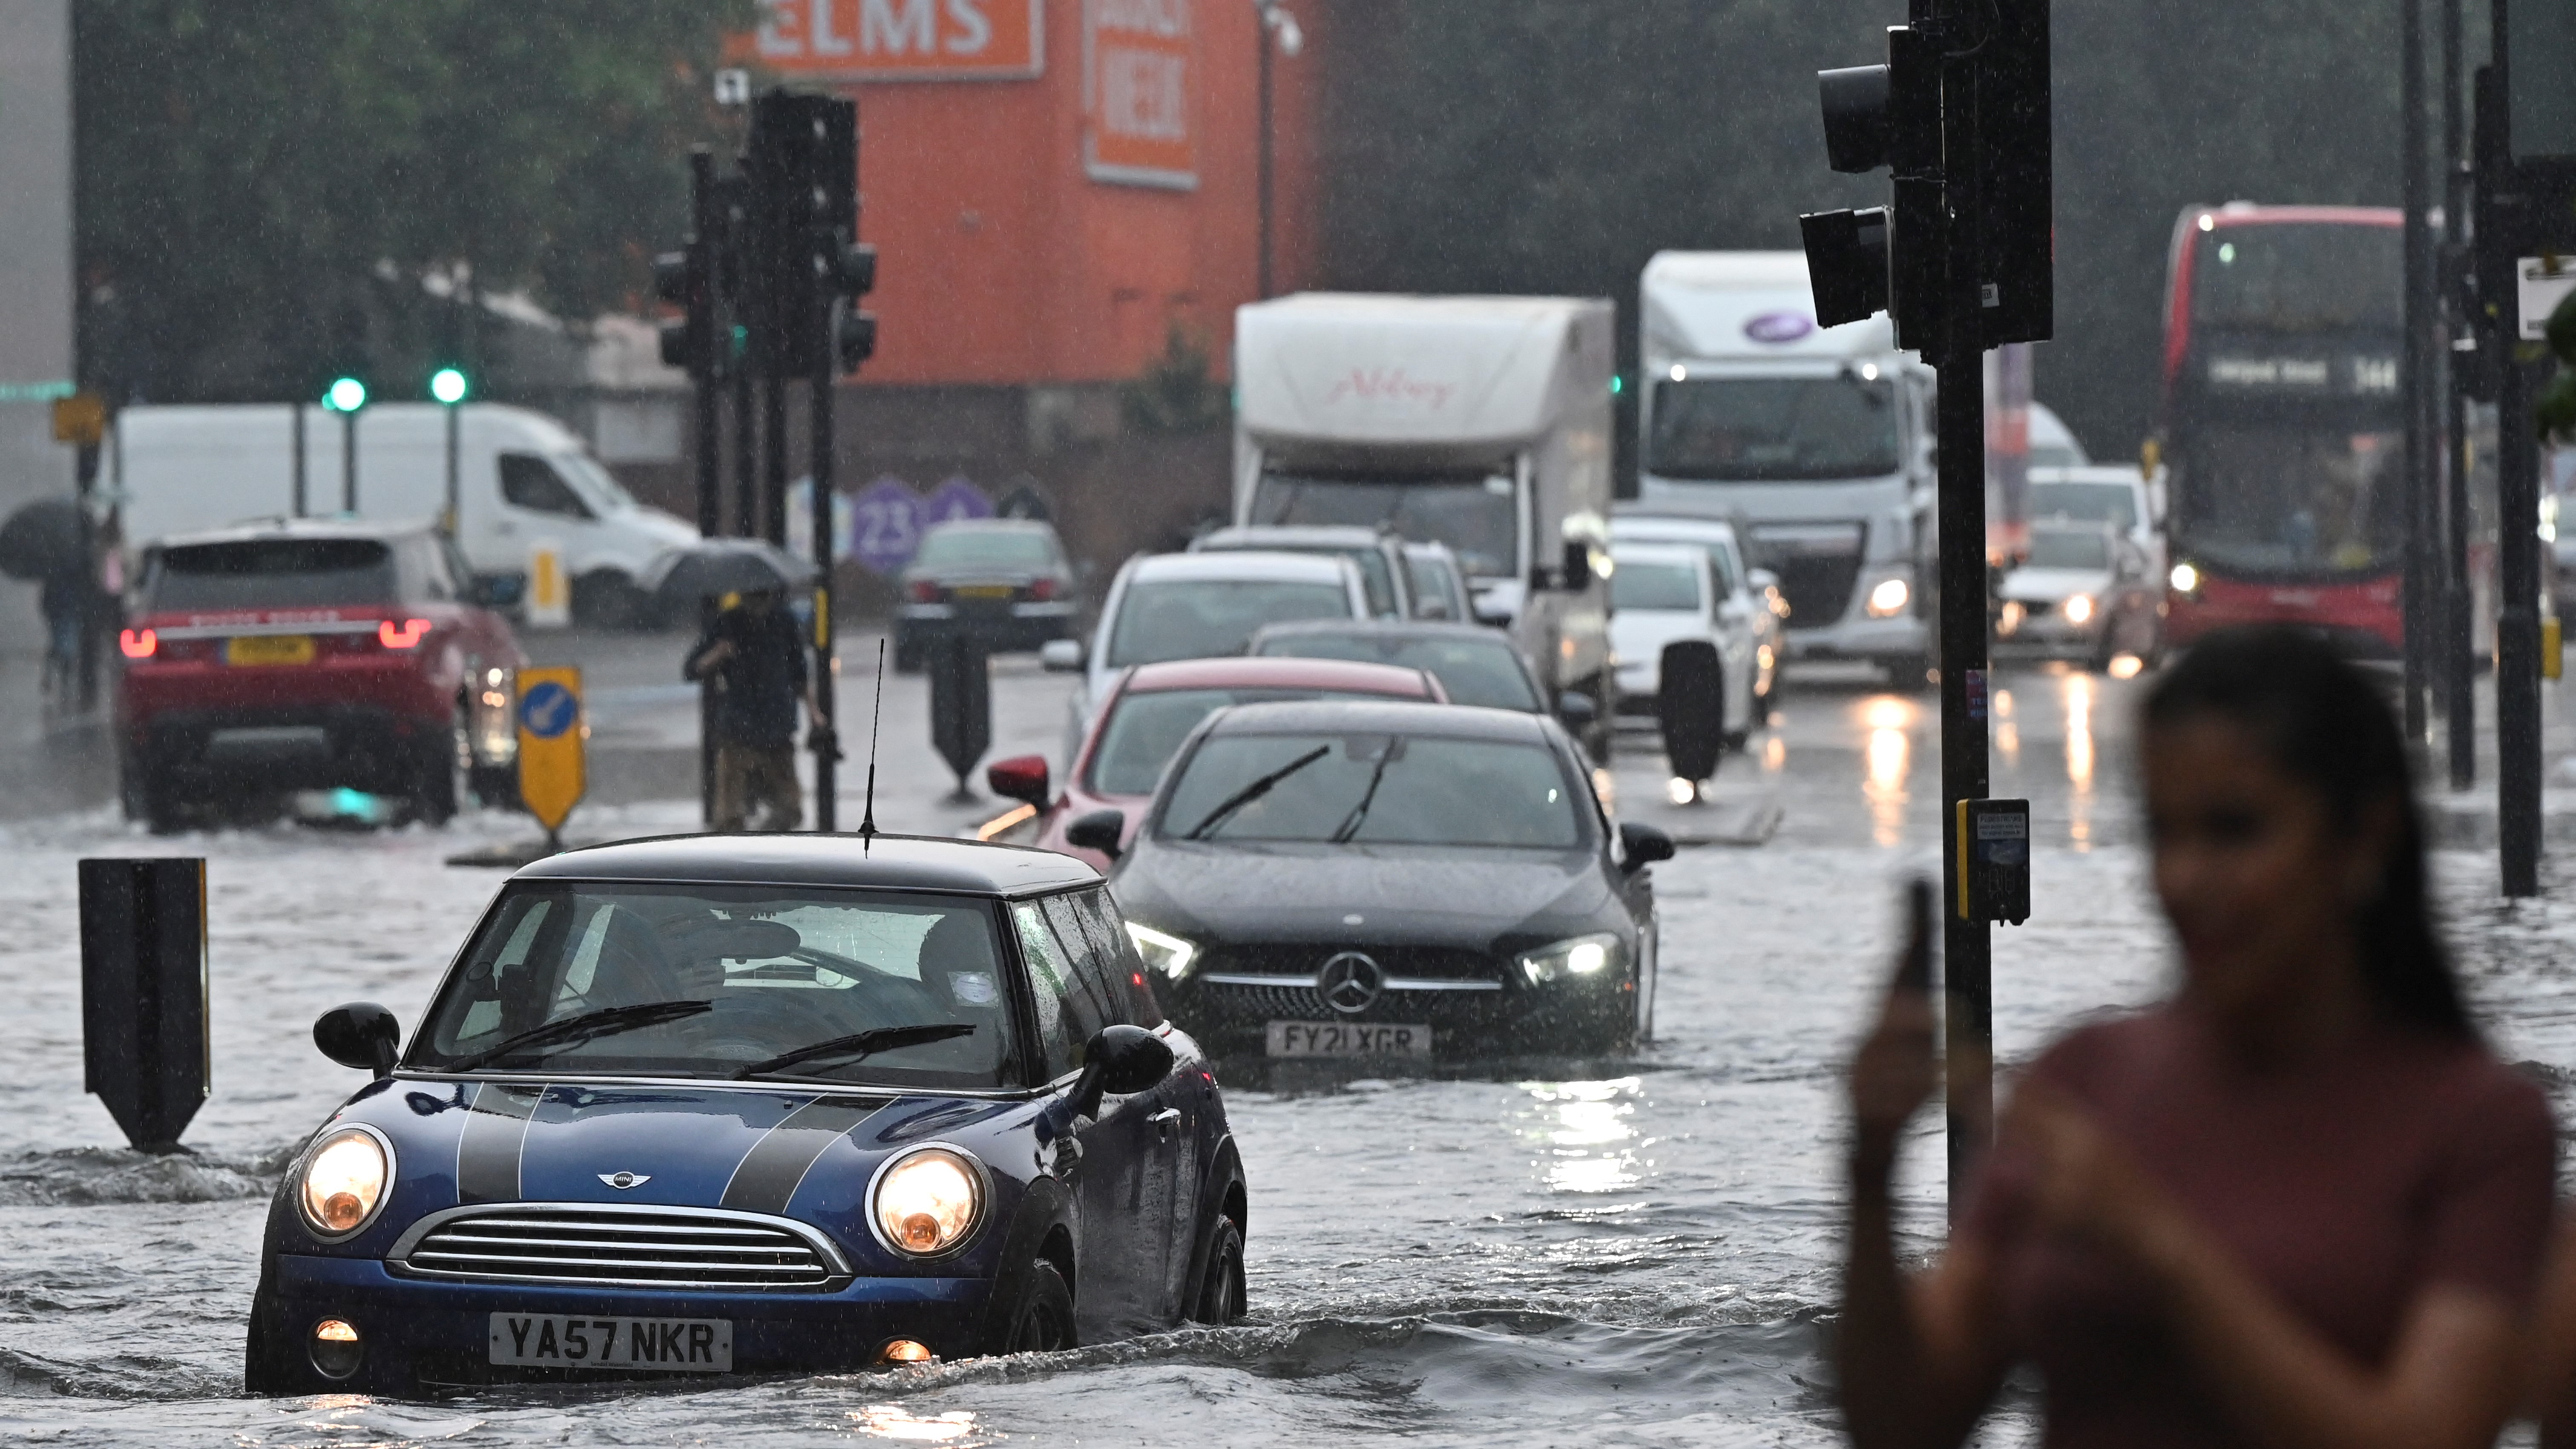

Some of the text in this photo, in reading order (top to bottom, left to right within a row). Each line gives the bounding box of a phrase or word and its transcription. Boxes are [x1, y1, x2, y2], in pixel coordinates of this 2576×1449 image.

[757, 0, 991, 56] ELMS
[1285, 1026, 1348, 1051] FY21
[509, 1318, 714, 1362] YA57 NKR
